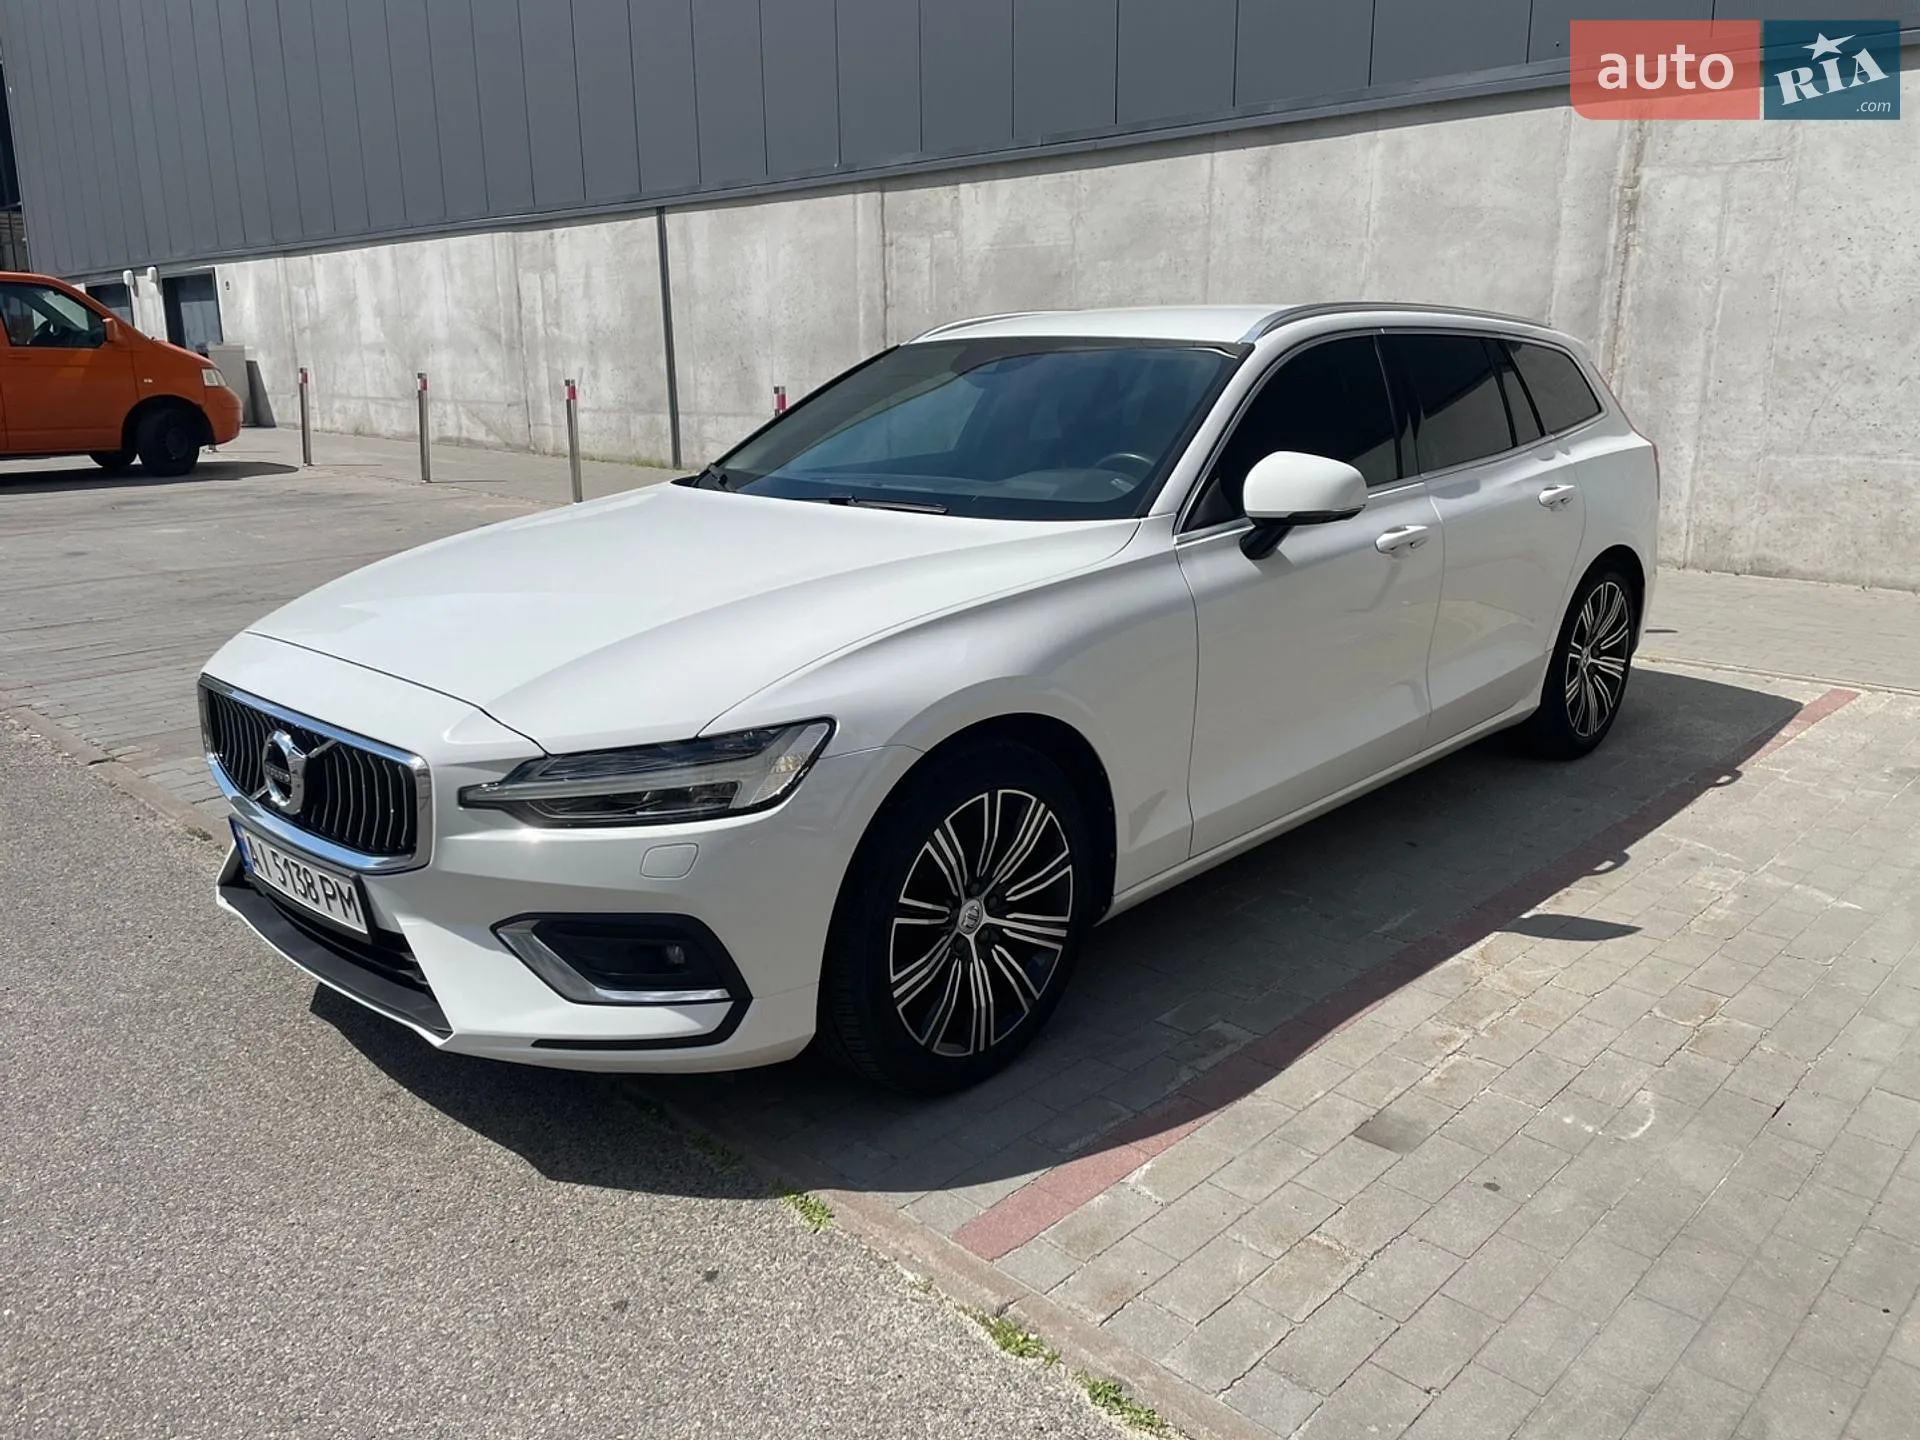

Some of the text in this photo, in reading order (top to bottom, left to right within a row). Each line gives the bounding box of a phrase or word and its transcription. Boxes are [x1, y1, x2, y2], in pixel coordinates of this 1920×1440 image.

[247, 835, 362, 925] AI 5138 PM
